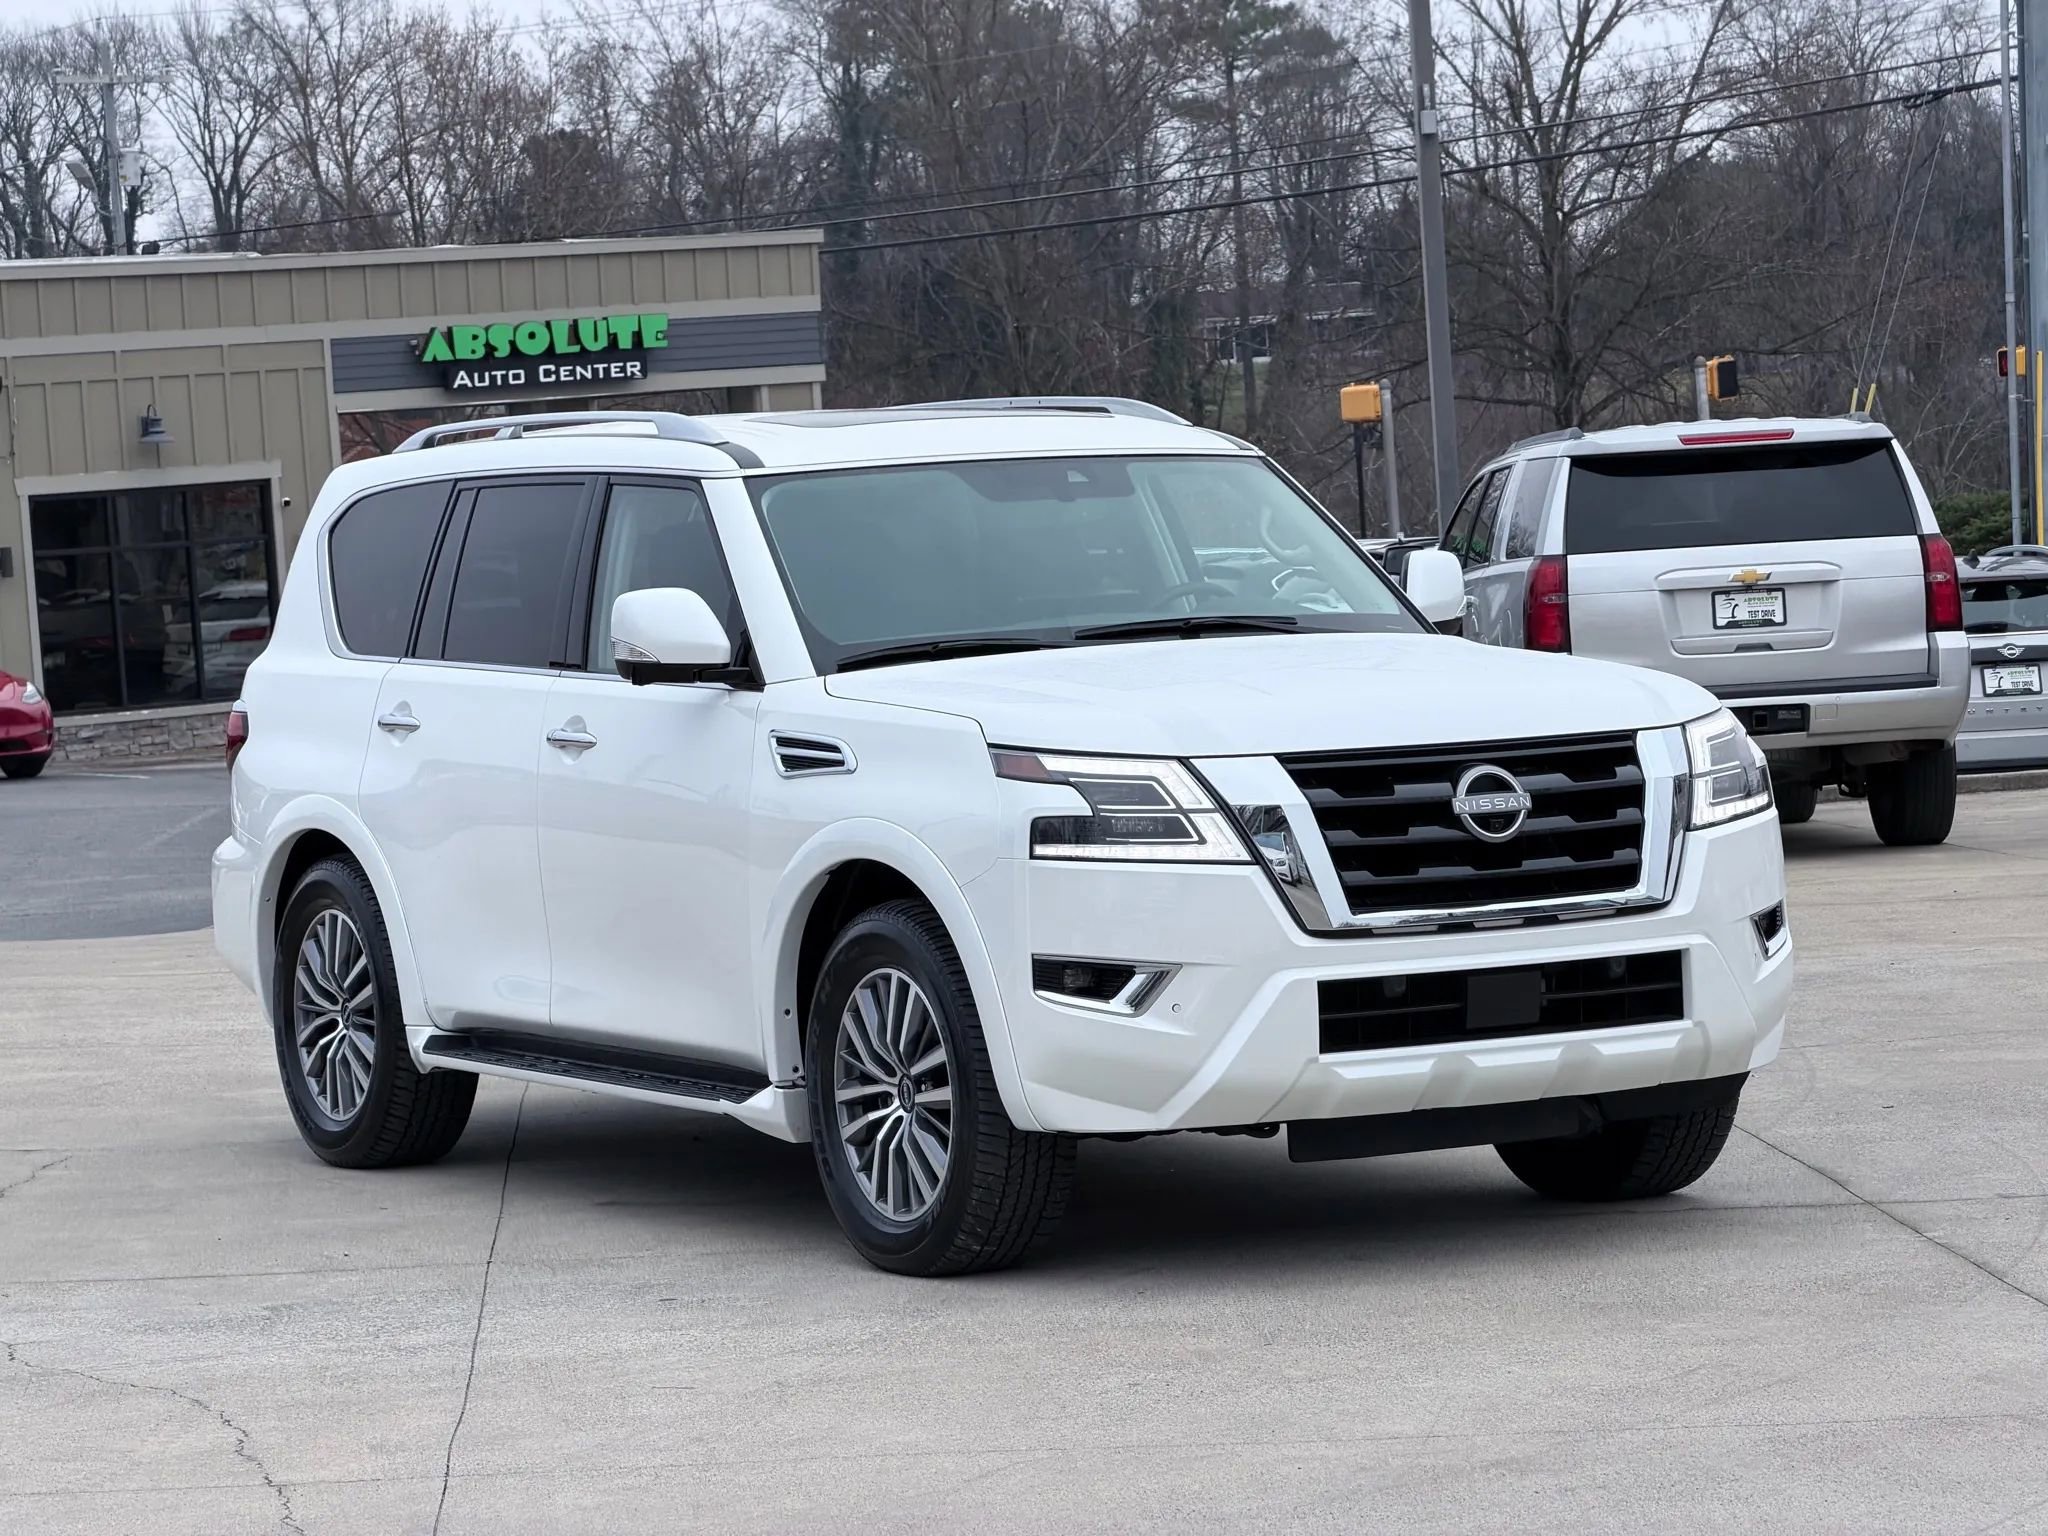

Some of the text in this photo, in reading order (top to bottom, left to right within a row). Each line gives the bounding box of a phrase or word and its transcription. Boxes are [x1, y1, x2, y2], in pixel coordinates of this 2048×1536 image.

[422, 313, 668, 362] ABSOLUTE
[453, 361, 642, 388] AUTO CENTER
[1747, 609, 1776, 618] TEST DRIVE
[2021, 680, 2034, 688] DRIVE
[1455, 796, 1530, 812] NISSAN
